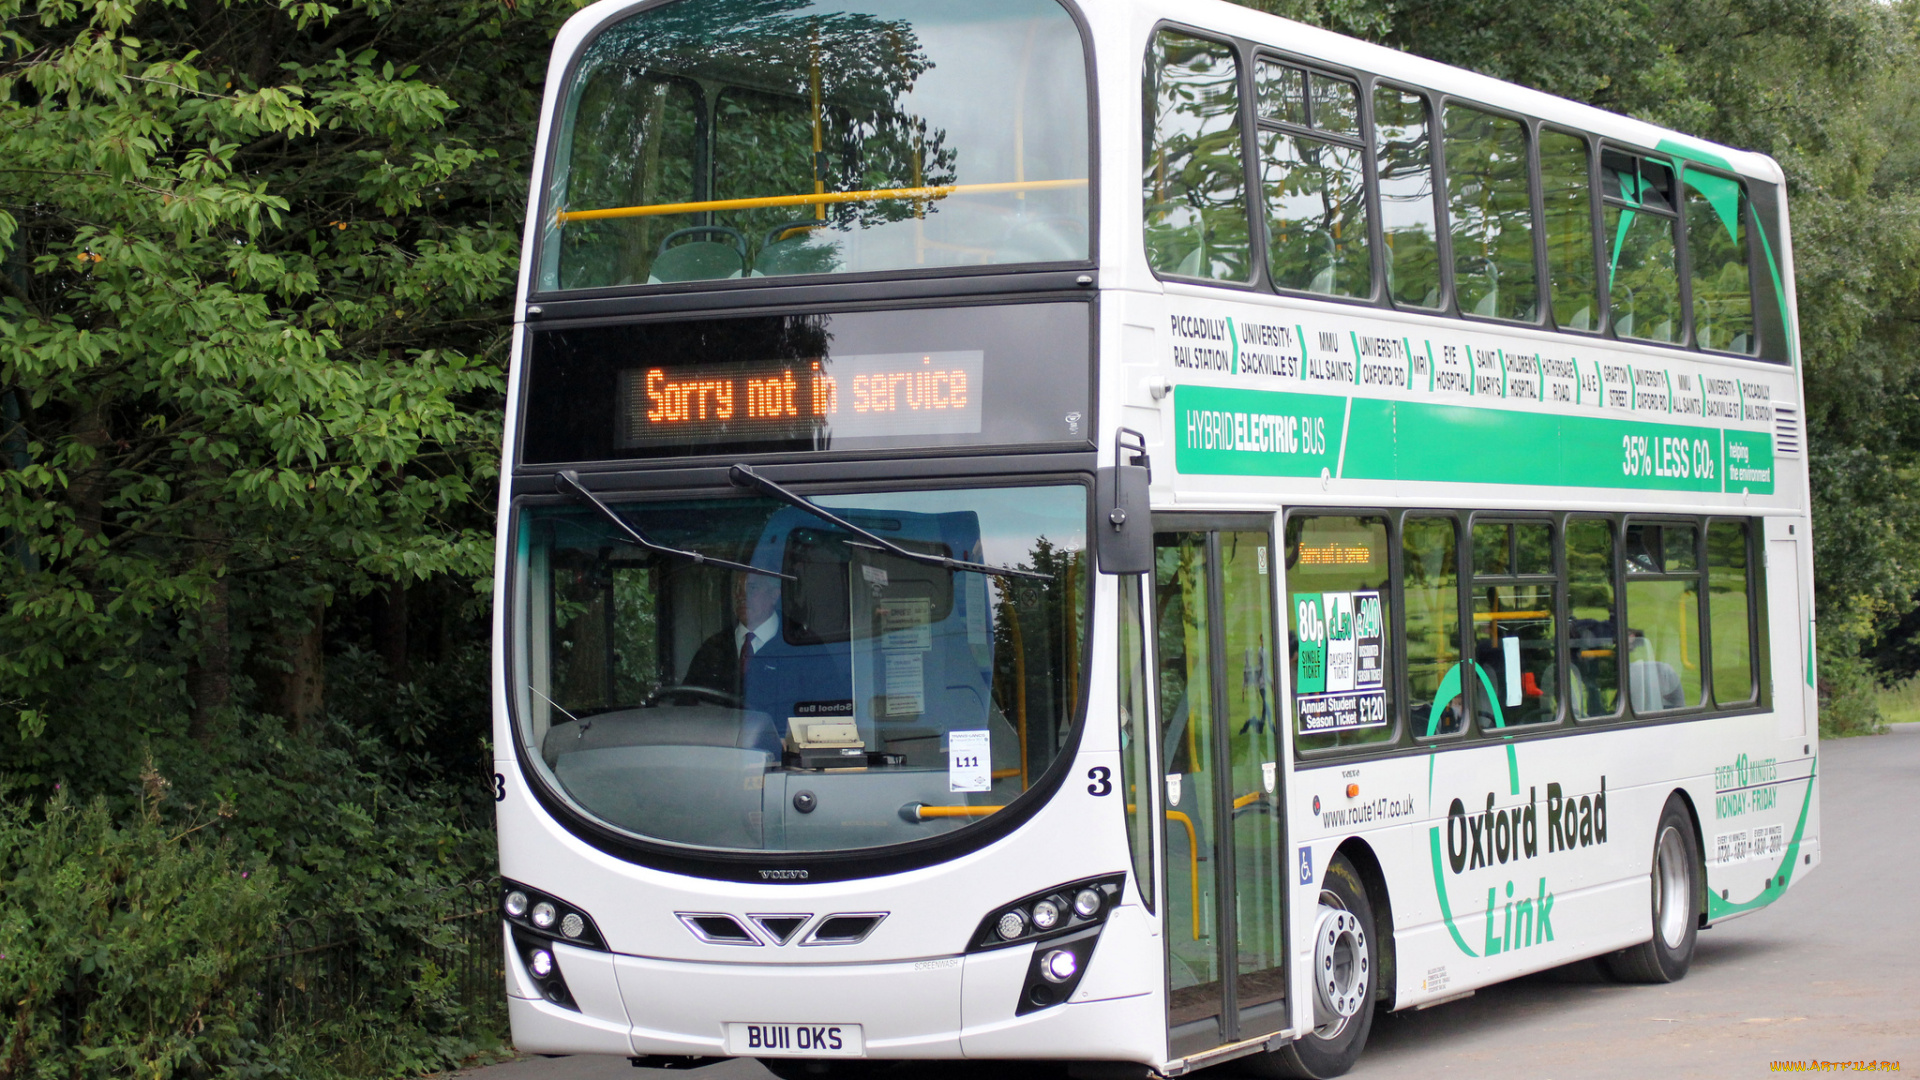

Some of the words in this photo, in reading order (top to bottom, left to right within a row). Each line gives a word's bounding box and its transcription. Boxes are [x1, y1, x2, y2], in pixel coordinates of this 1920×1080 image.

[1171, 315, 1225, 341] PICCADILLY
[1319, 331, 1338, 353] MMU
[1174, 345, 1193, 368] RAIL
[1194, 349, 1229, 371] STATION
[1240, 355, 1286, 376] SACKVILLE
[1288, 358, 1298, 377] ST
[1413, 355, 1428, 375] MRI
[1444, 345, 1457, 366] EYE
[1476, 349, 1495, 369] SAINT
[1505, 353, 1537, 374] CHILDREN'S
[1309, 360, 1324, 380] ALL
[1325, 362, 1353, 382] SAINTS
[1363, 363, 1391, 385] OXFORD
[1392, 365, 1404, 386] RD
[1436, 371, 1469, 392] HOSPITAL
[1604, 365, 1628, 384] GRAFTON
[646, 368, 733, 421] Sorry
[747, 370, 797, 417] not
[811, 361, 837, 415] in
[853, 356, 967, 412] service
[1476, 375, 1500, 396] MARY'S
[1510, 378, 1537, 398] HOSPITAL
[1553, 383, 1570, 402] ROAD
[1678, 374, 1691, 391] MMU
[1742, 383, 1770, 400] PICCADILLY
[1609, 389, 1627, 407] STREET
[1637, 392, 1658, 410] OXFORD
[1673, 396, 1682, 413] ALL
[1683, 397, 1701, 415] SAINTS
[1707, 400, 1733, 418] SACKVILLE
[1745, 404, 1754, 420] RAIL
[1755, 405, 1773, 421] STATION
[1302, 416, 1325, 455] BUS
[1622, 434, 1652, 477] 35%
[1655, 436, 1689, 478] LESS
[1729, 441, 1749, 464] helping
[1729, 464, 1739, 480] the
[1739, 465, 1770, 482] environment
[1299, 599, 1324, 648] 80p
[1302, 650, 1320, 664] SINGLE
[1329, 652, 1352, 666] DAYSAVER
[1303, 664, 1320, 679] TICKET
[1334, 666, 1349, 679] TICKET
[1301, 698, 1327, 715] Annual
[1328, 696, 1357, 712] Student
[1360, 696, 1384, 722] £120
[1306, 714, 1334, 729] Season
[1335, 711, 1357, 725] Ticket
[956, 756, 979, 768] L11
[1715, 764, 1734, 790] EVERY
[1735, 753, 1748, 788] 10
[1750, 758, 1777, 784] MINUTES
[494, 773, 506, 802] 3
[1087, 766, 1112, 798] 3
[1323, 793, 1414, 828] www.route147.co.uk
[1716, 791, 1747, 819] MONDAY
[1752, 786, 1777, 812] FRIDAY
[1448, 786, 1538, 874] Oxford
[1547, 775, 1608, 853] Road
[759, 869, 809, 880] VOLVO
[1484, 877, 1555, 957] Link
[914, 959, 958, 971] SCREENWASH
[748, 1025, 790, 1049] BU11
[797, 1026, 842, 1050] OKS
